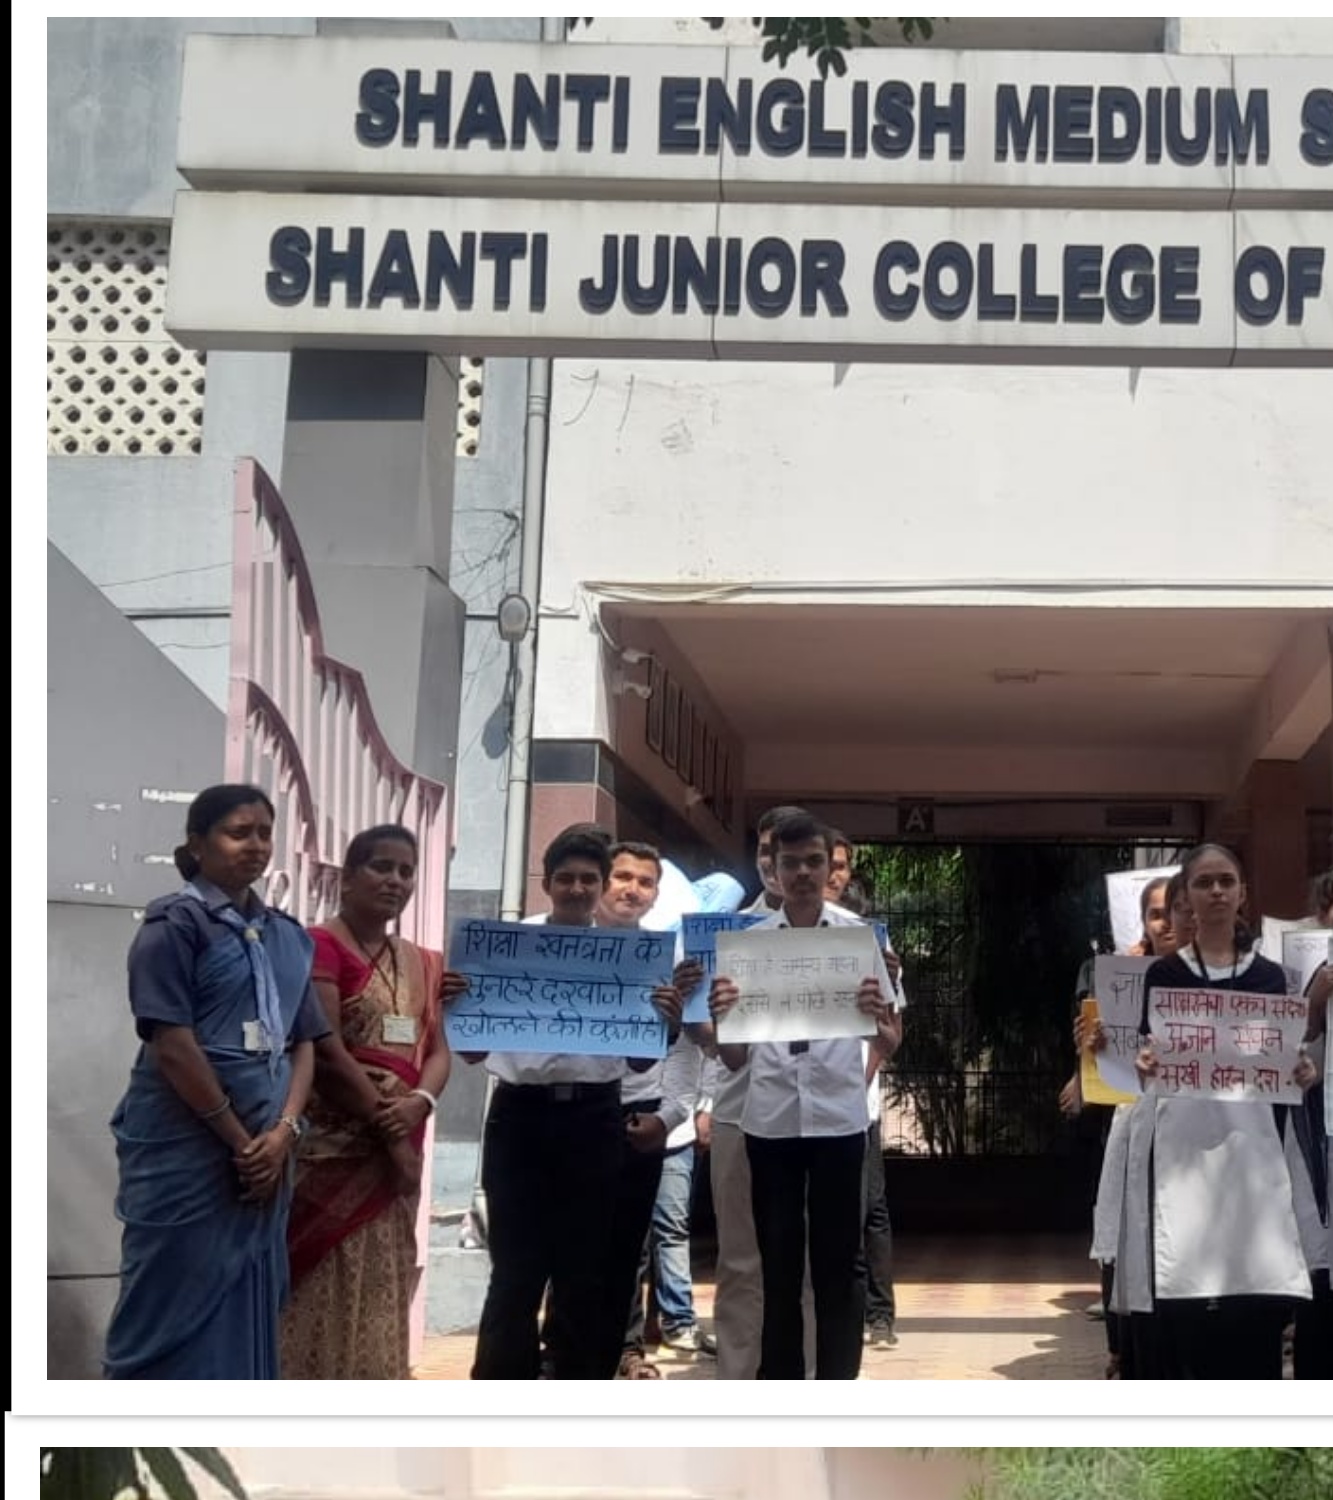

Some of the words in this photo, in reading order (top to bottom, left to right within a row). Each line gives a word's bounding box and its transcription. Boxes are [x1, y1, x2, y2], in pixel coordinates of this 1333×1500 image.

[356, 69, 630, 153] SHANTI
[659, 76, 966, 161] ENGLISH
[995, 83, 1270, 164] MEDIUM
[266, 226, 547, 312] SHANTI
[579, 233, 849, 318] JUNIOR
[873, 240, 1202, 325] COLLEGE
[1233, 246, 1325, 327] OF
[463, 921, 526, 959] शिक्षा
[634, 931, 663, 964] के
